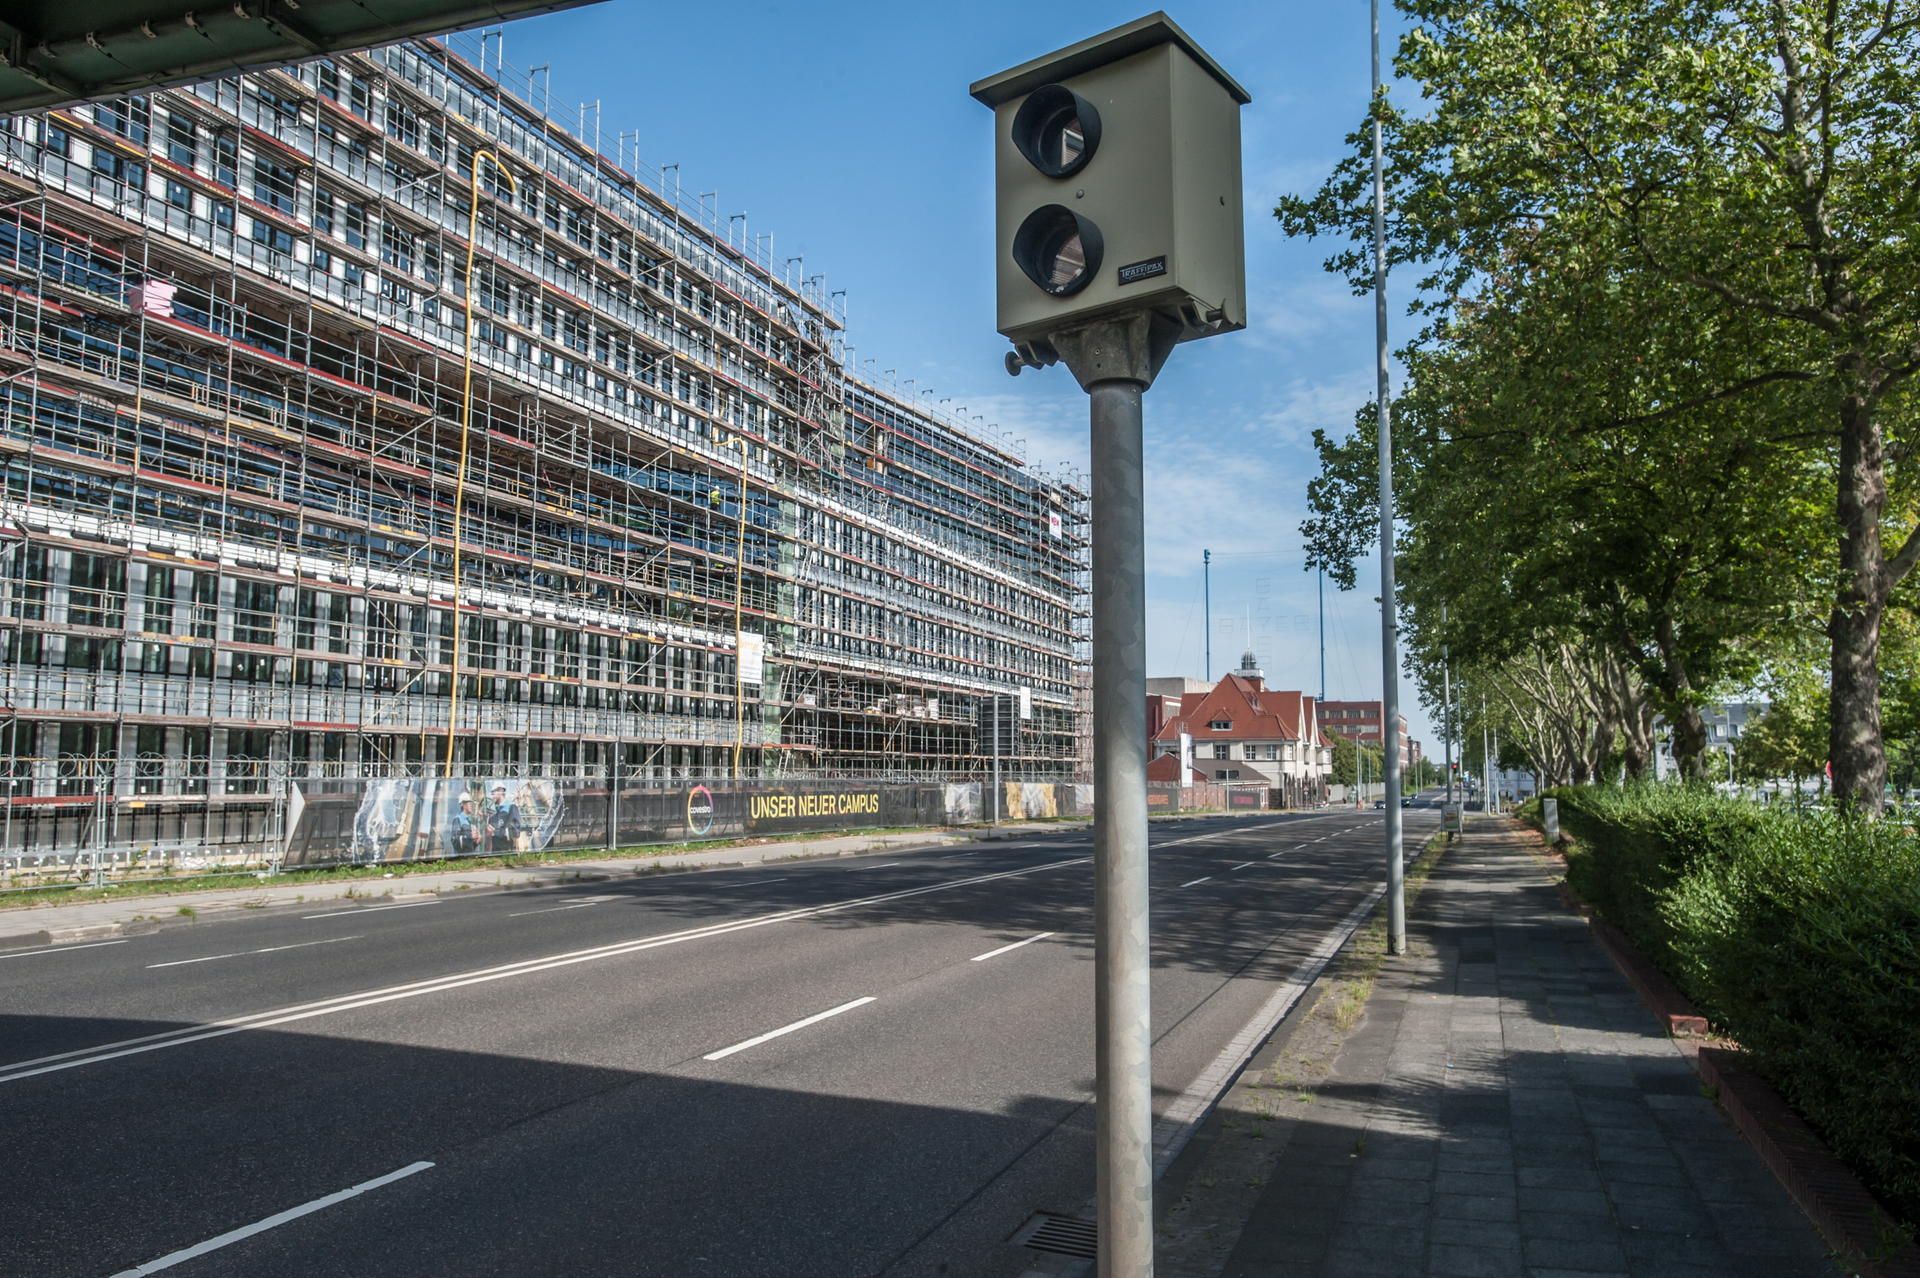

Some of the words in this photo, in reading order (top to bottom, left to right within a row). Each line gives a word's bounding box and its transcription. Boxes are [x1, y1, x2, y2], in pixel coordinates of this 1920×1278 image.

[750, 796, 795, 819] UNSER
[798, 795, 836, 817] NEUER
[838, 794, 879, 815] CAMPUS
